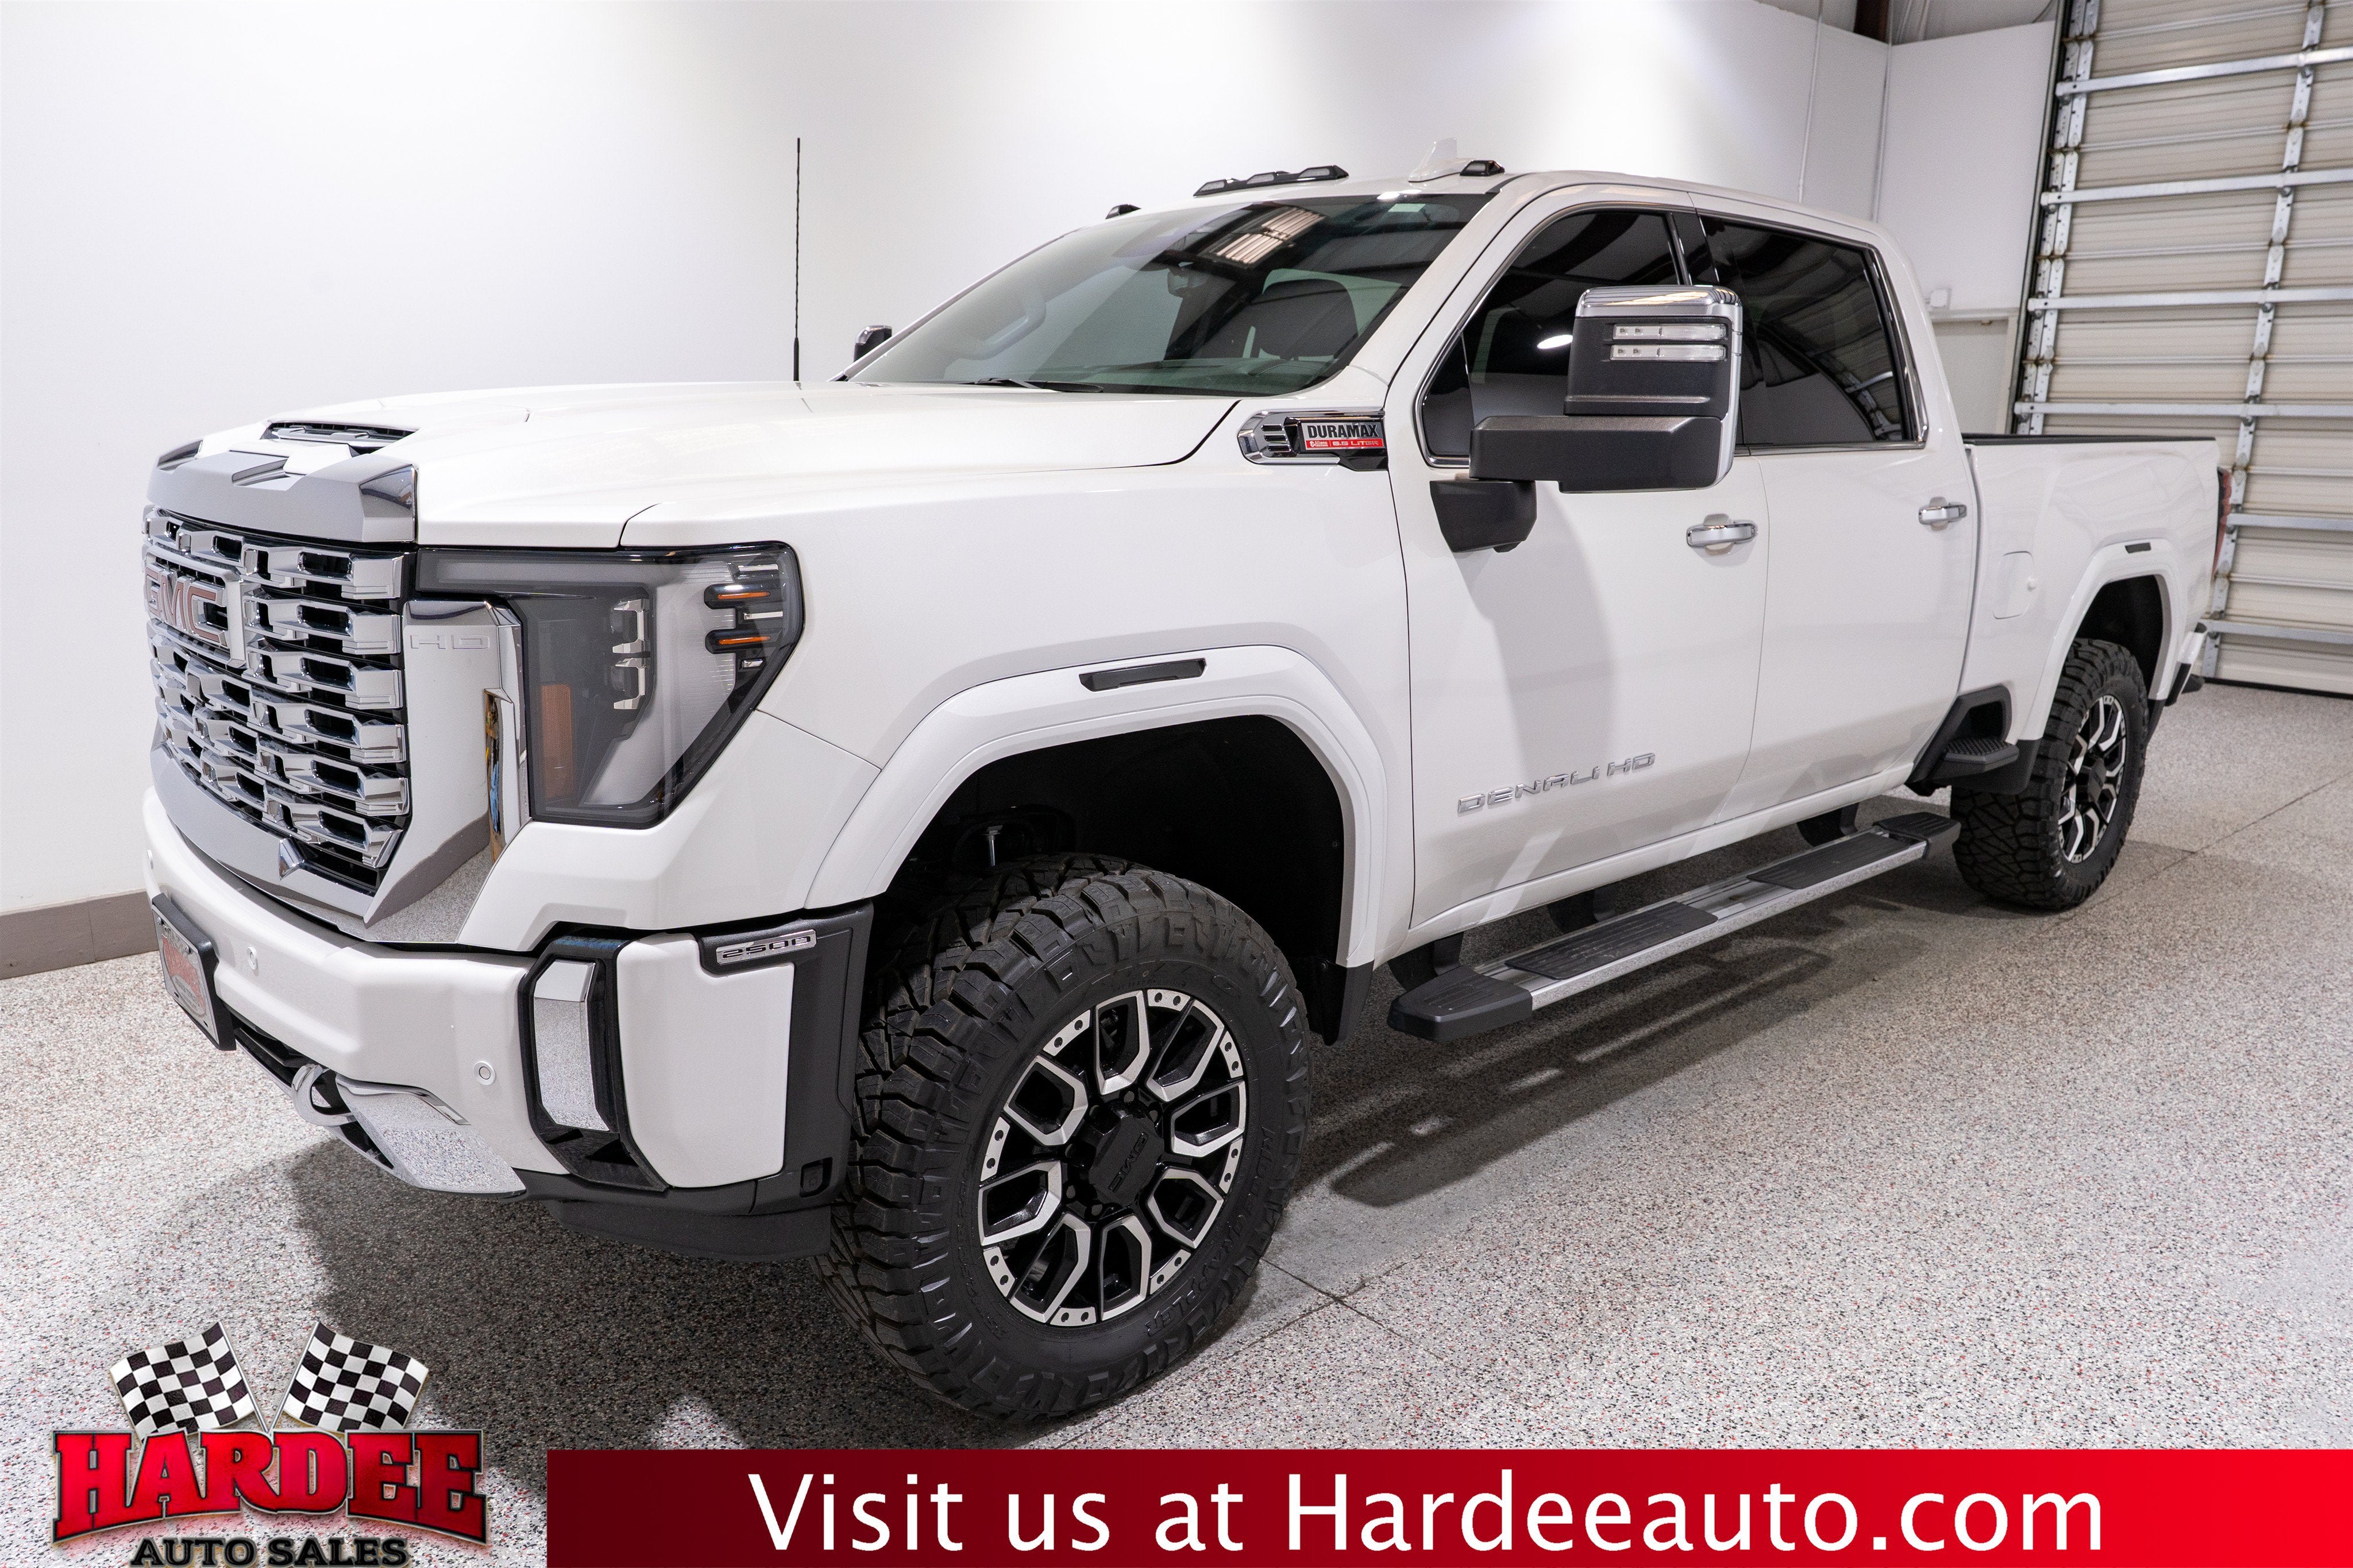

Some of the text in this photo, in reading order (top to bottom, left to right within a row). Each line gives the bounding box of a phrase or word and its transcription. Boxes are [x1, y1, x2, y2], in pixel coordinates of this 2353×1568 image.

[1307, 424, 1379, 438] DURAMAX
[145, 563, 229, 649] GMC
[410, 634, 489, 649] HD
[1457, 752, 1656, 814] DENALI HD
[722, 935, 811, 959] 2500
[1108, 1131, 1149, 1194] GMC
